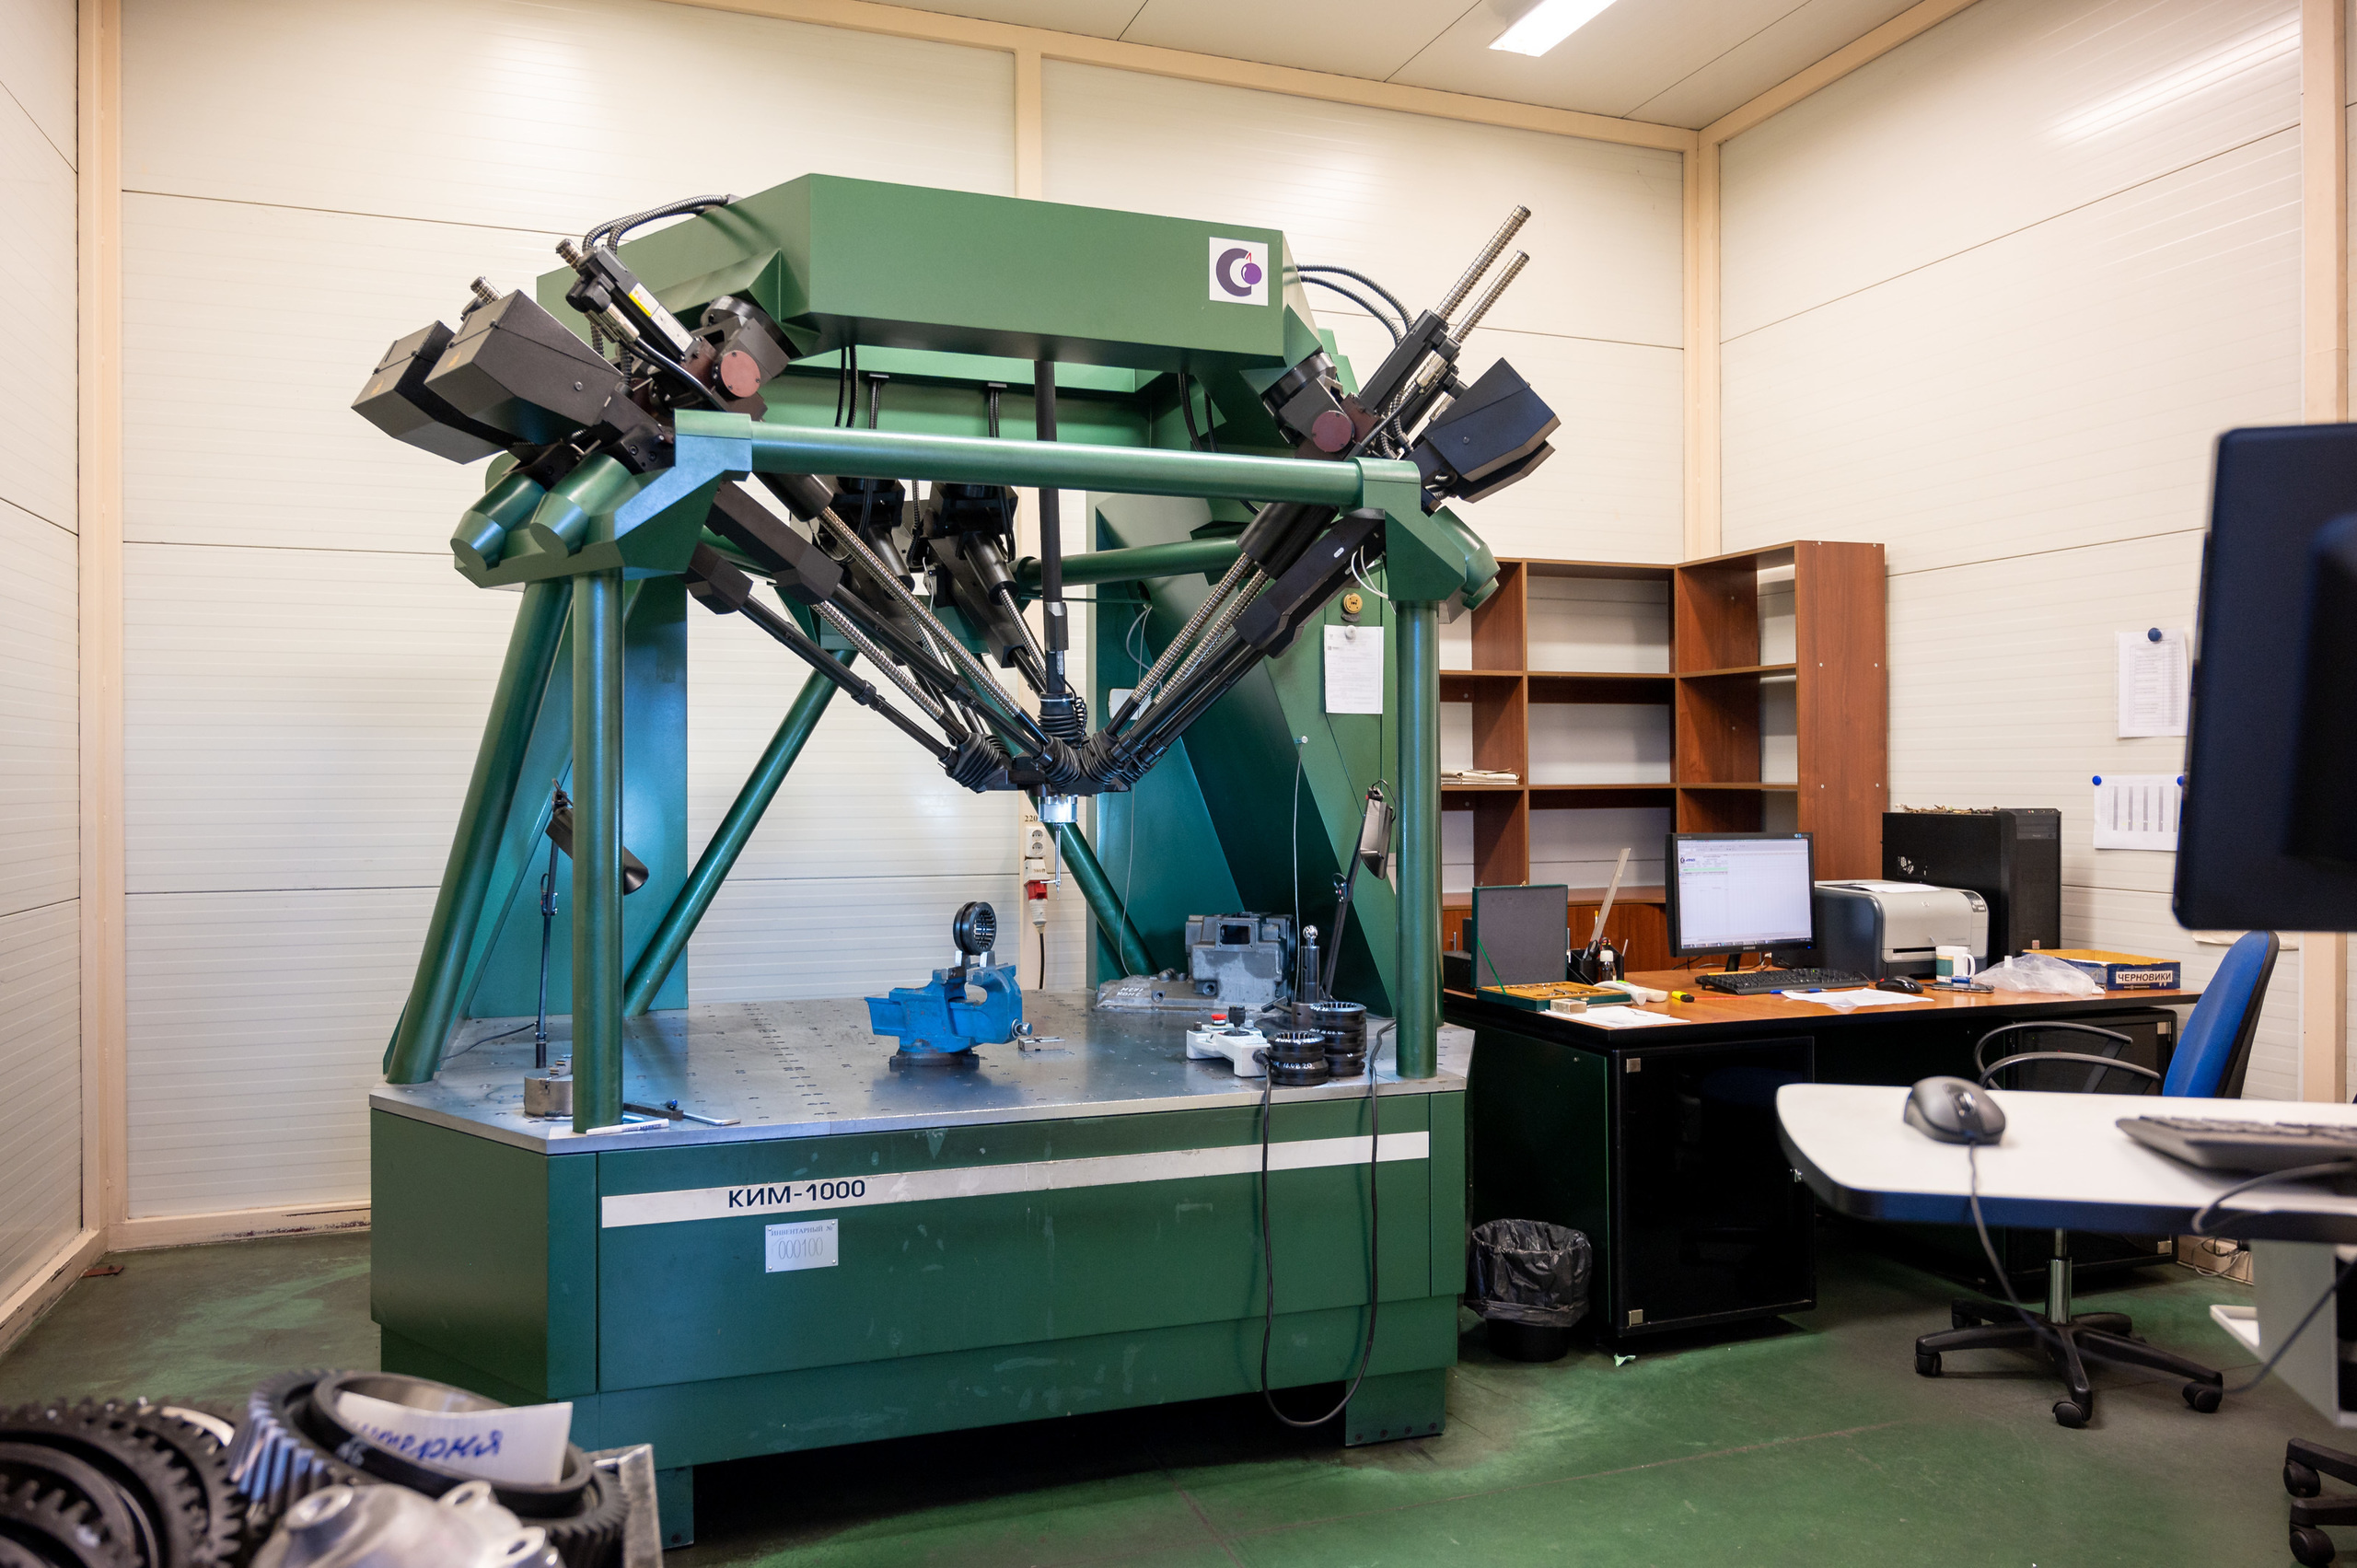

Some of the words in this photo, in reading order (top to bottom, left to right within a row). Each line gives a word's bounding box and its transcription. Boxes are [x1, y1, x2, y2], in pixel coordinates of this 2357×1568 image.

[2118, 972, 2171, 981] ЧЕРНОВИКИ
[728, 1179, 865, 1208] КИМ-1000
[771, 1225, 823, 1237] ИНВЕНТАРНЫЙ
[778, 1237, 823, 1260] 000100
